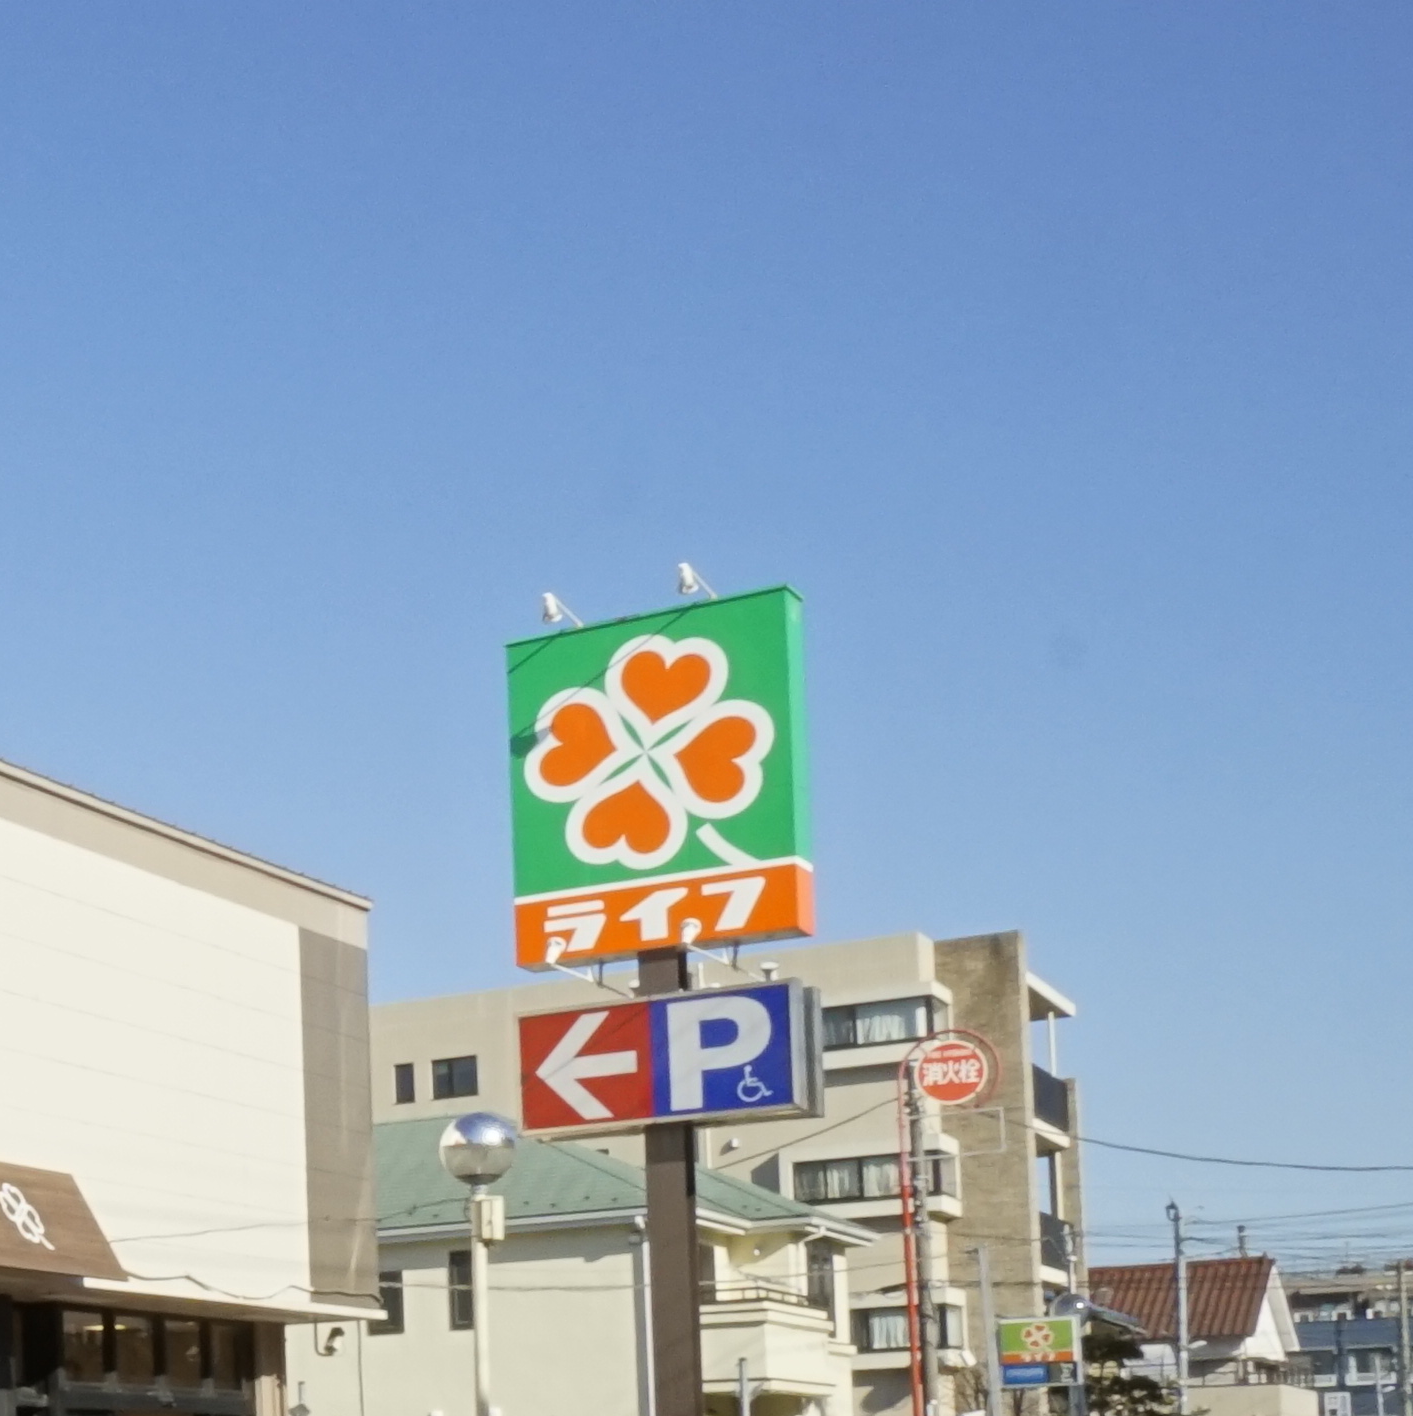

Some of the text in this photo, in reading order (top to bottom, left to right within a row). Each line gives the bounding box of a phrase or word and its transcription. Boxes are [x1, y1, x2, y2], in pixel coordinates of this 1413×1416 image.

[544, 876, 766, 953] ライフ
[667, 996, 772, 1112] P
[922, 1058, 981, 1087] 消火栓
